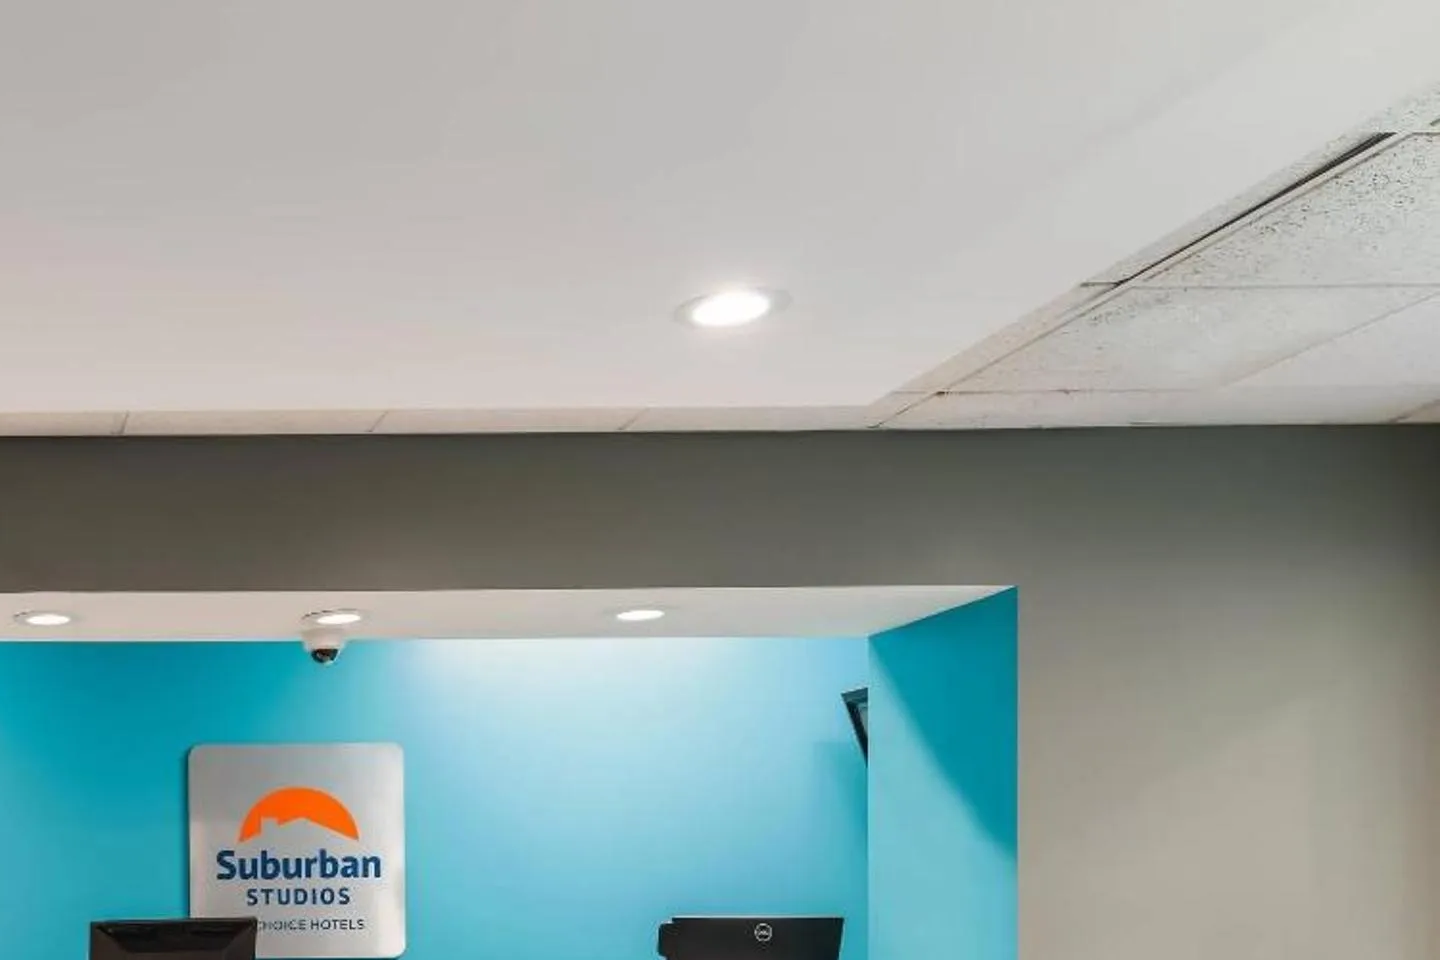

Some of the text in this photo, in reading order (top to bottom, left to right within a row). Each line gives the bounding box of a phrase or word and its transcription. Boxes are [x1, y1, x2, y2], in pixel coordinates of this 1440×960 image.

[215, 847, 381, 881] Suburban
[246, 887, 351, 907] STUDIOS
[310, 918, 366, 931] HOTELS
